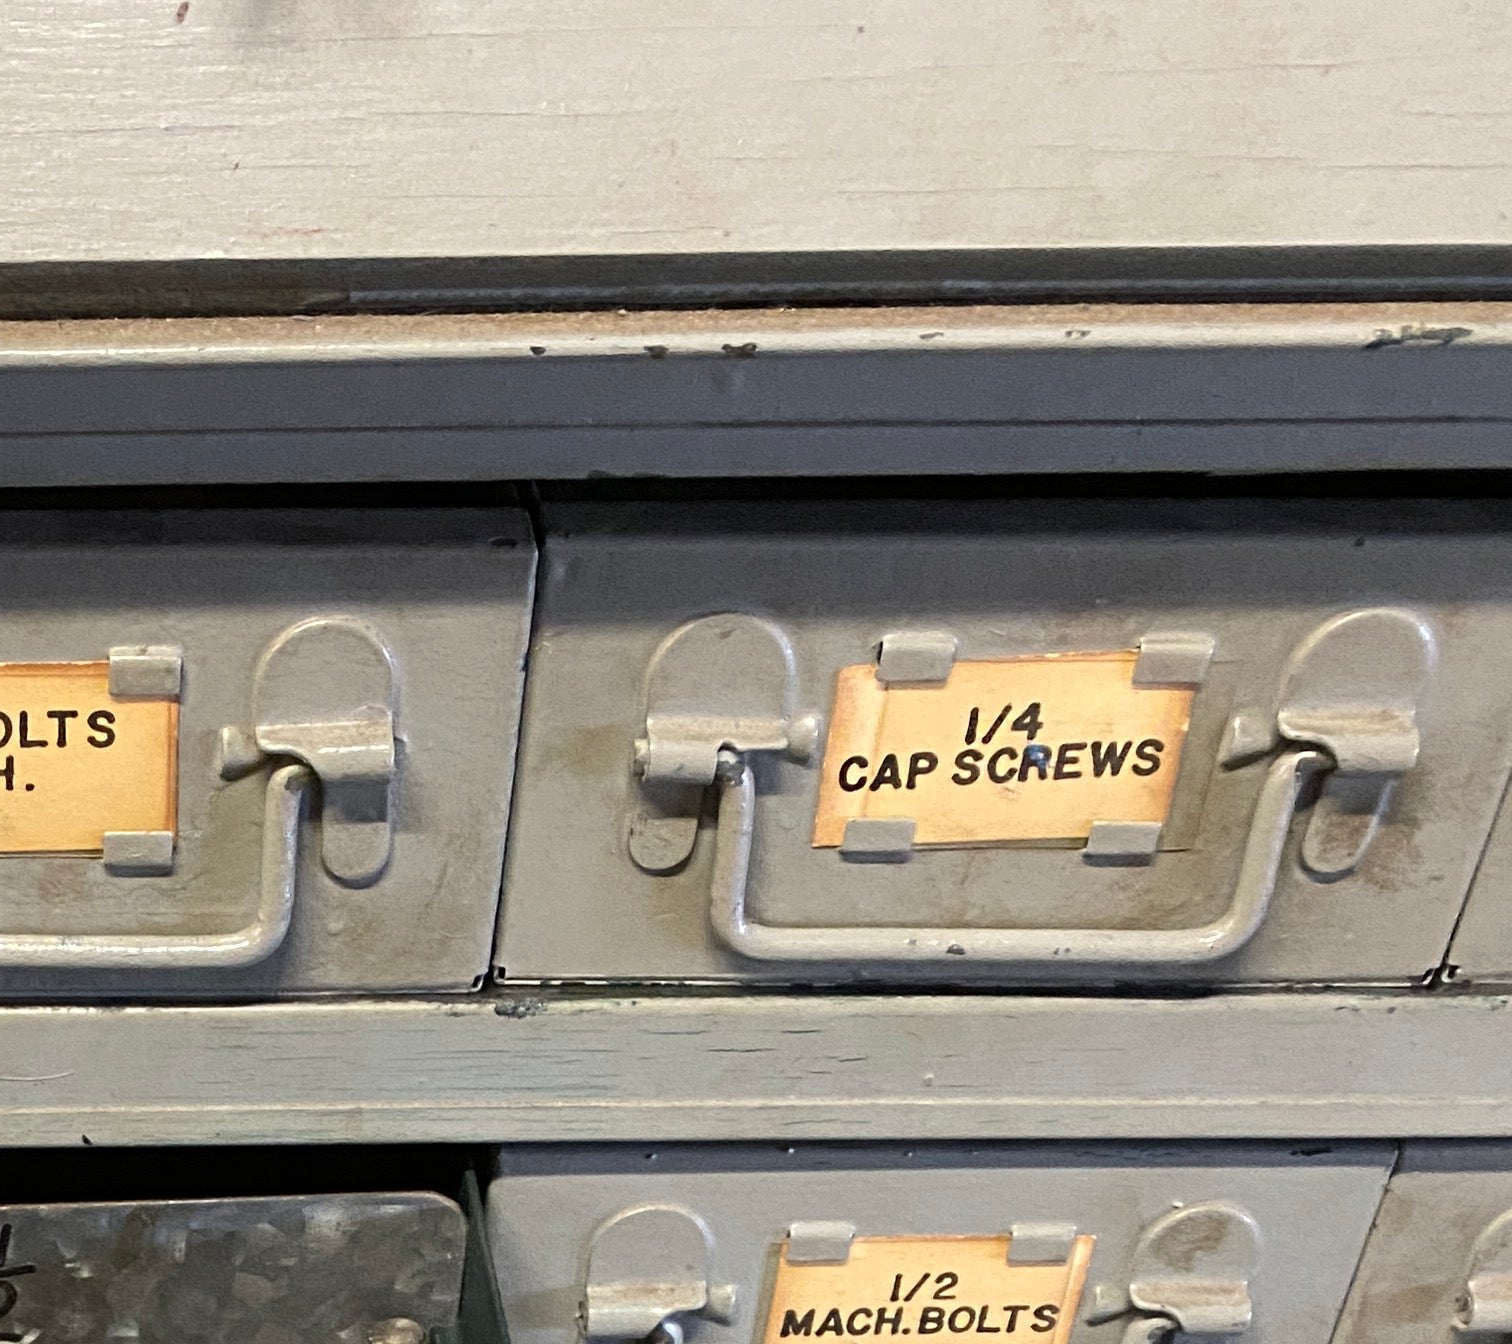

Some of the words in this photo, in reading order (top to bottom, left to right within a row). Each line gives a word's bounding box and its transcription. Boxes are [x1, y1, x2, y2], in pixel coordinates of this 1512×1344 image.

[965, 702, 1044, 745] 1/4
[838, 751, 939, 792] CAP
[951, 738, 1166, 785] SCREWS
[889, 1271, 959, 1303] 1/2
